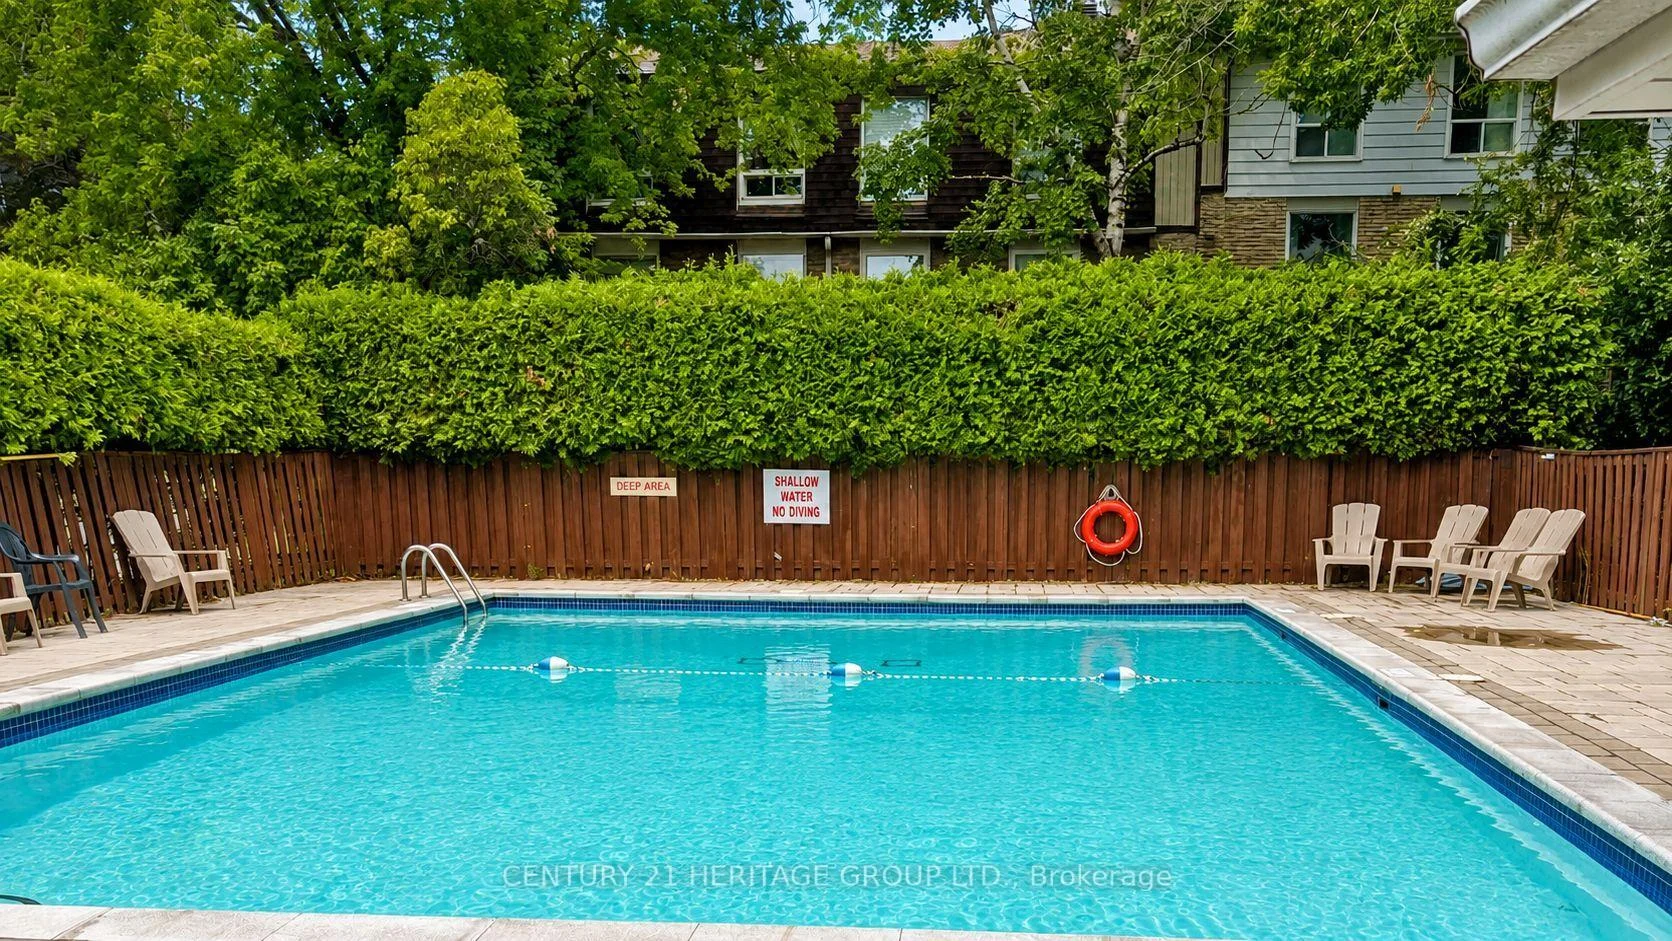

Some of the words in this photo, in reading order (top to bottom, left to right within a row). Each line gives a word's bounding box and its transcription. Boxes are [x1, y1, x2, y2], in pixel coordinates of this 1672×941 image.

[616, 481, 642, 491] DEEP
[643, 481, 671, 491] AREA
[774, 475, 819, 488] SHALLOW
[780, 491, 813, 502] WATER
[772, 506, 786, 518] NO
[789, 506, 820, 518] DIVING
